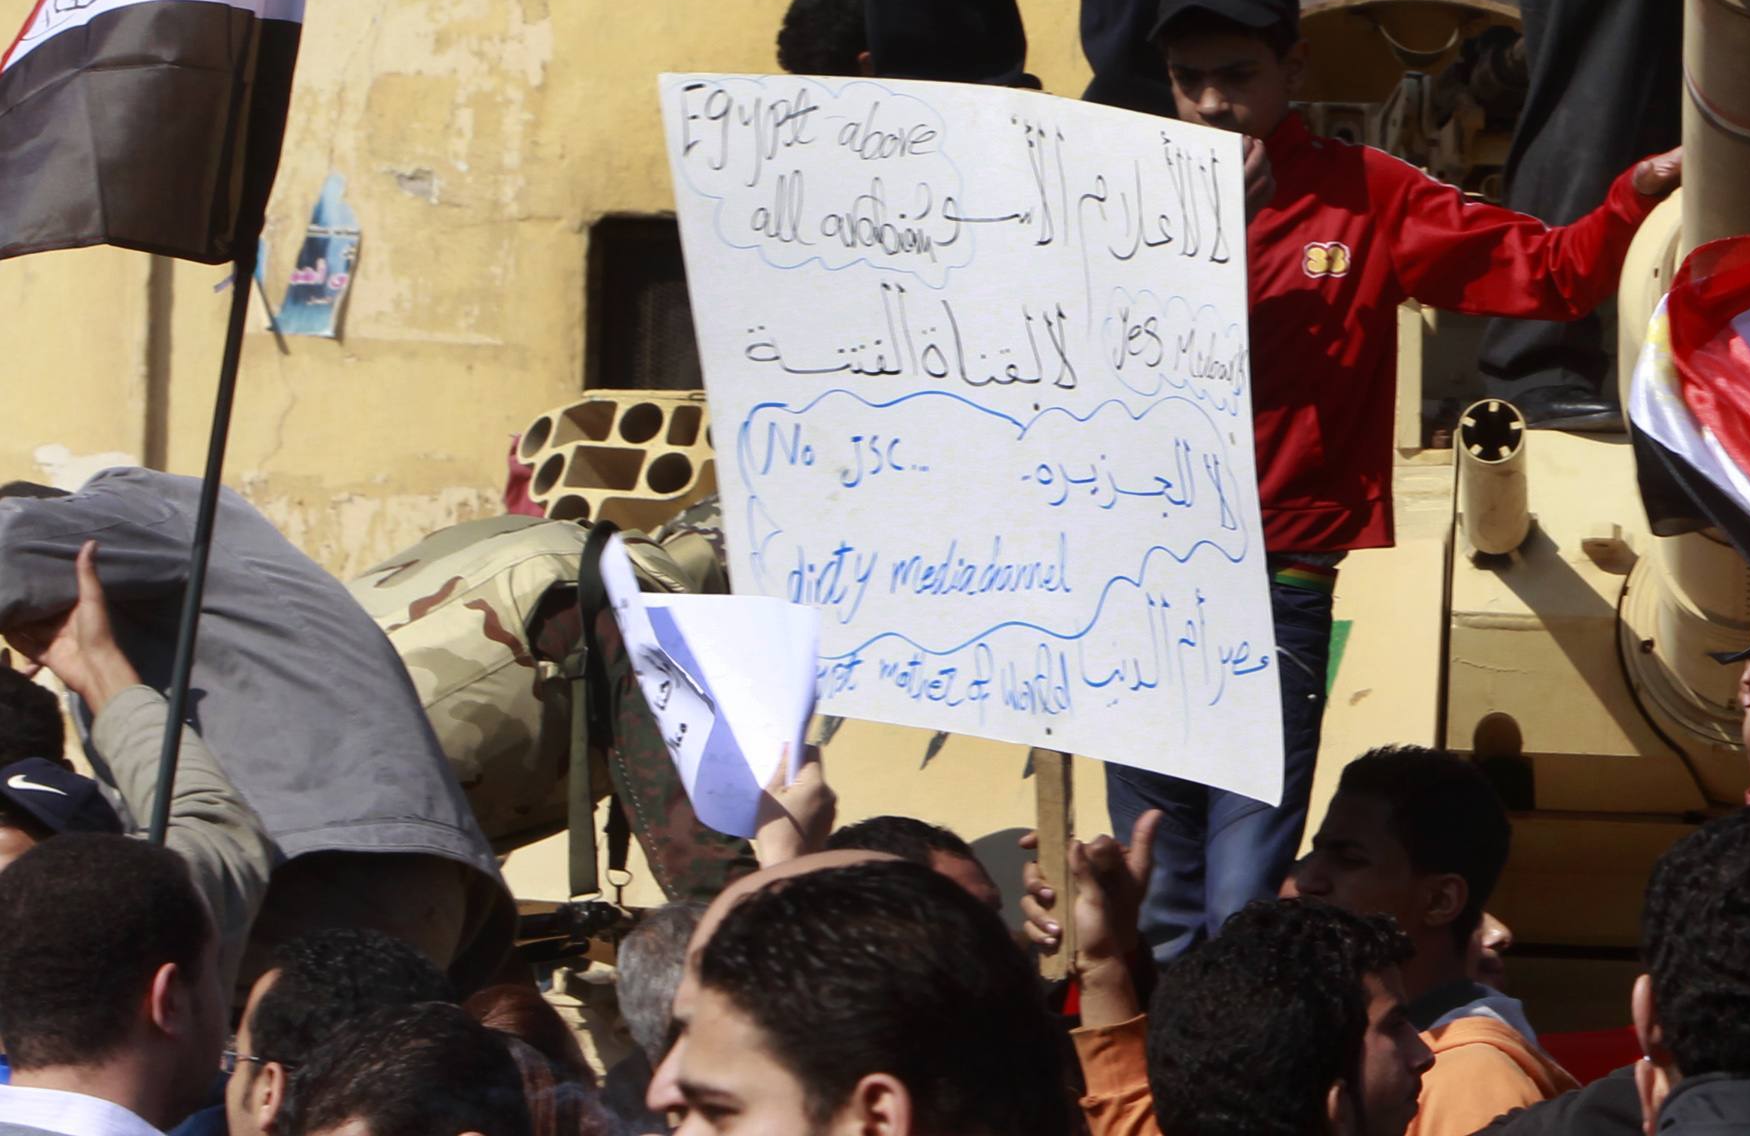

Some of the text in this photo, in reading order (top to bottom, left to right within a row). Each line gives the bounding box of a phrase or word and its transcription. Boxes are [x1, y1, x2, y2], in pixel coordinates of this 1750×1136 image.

[682, 83, 938, 188] Egypt above
[750, 168, 817, 245] all
[761, 420, 815, 476] No
[1208, 640, 1270, 707] مصر
